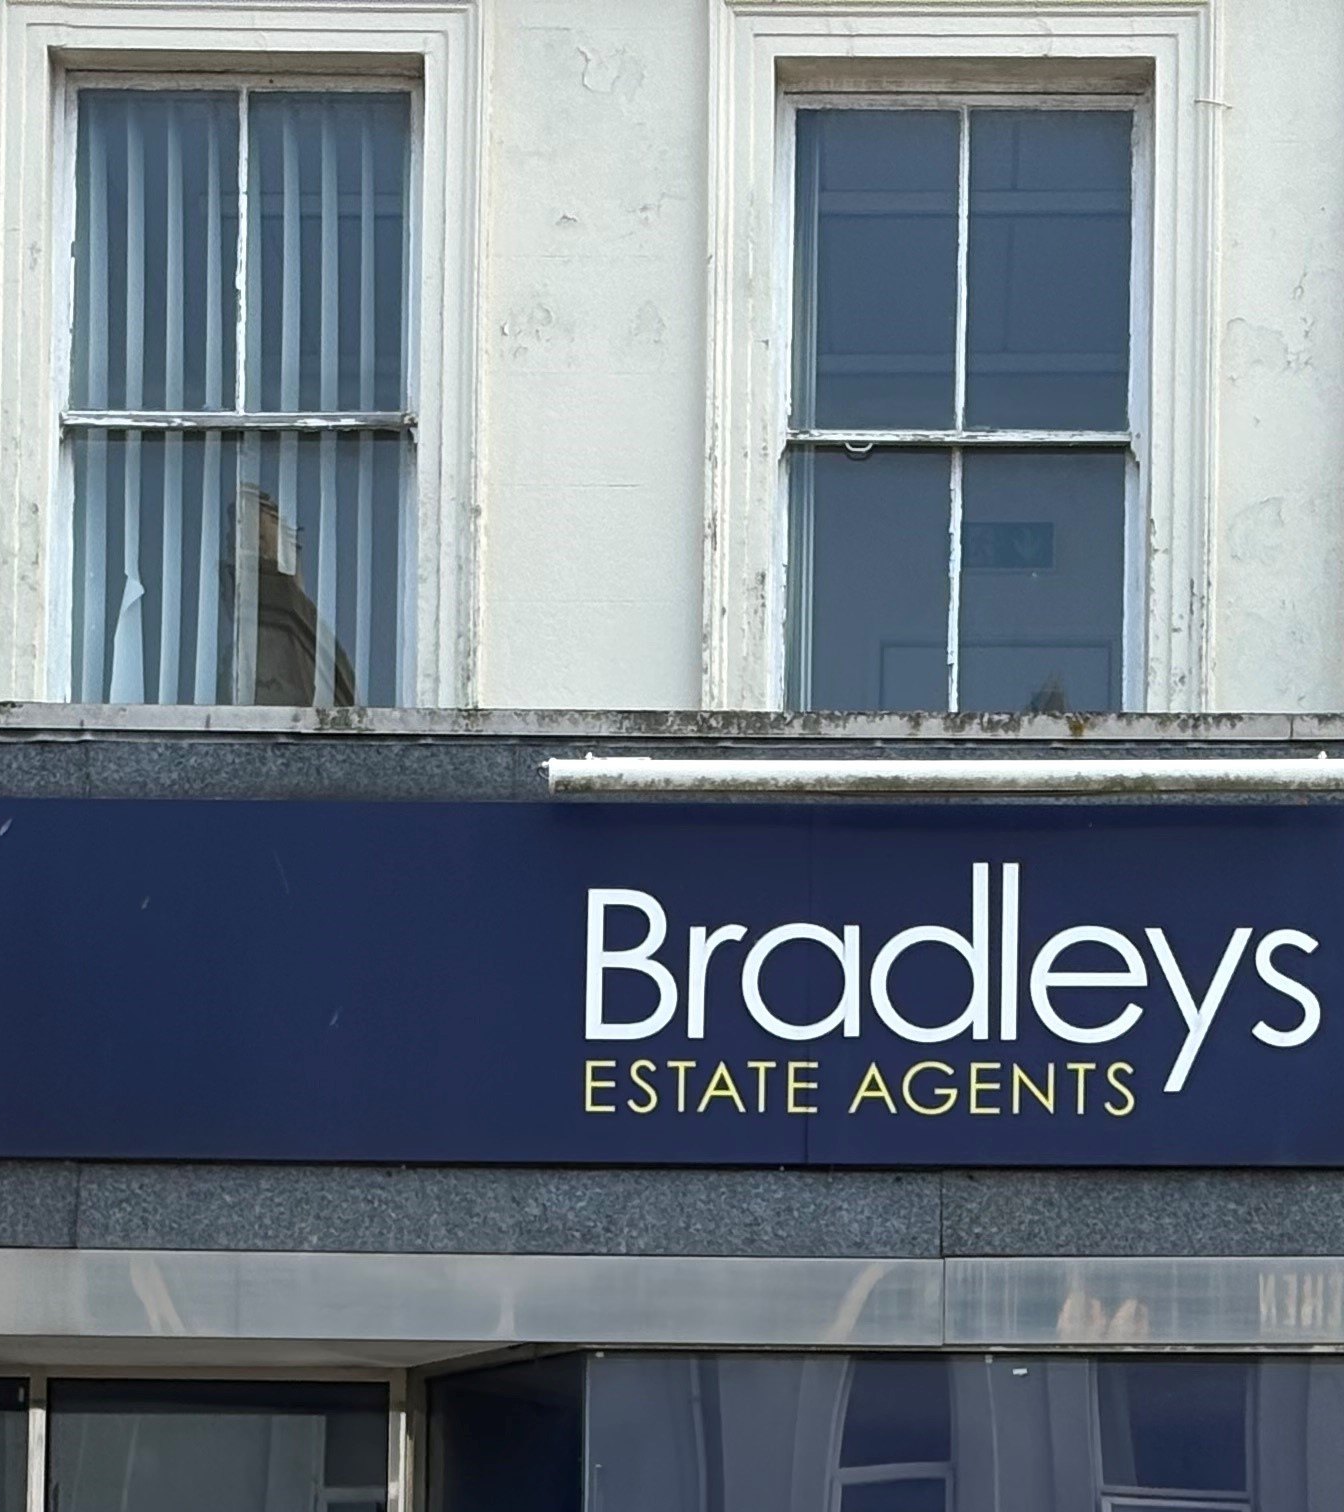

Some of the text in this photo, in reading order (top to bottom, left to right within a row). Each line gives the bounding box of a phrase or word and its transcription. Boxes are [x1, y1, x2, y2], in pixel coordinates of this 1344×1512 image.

[584, 862, 1322, 1093] Bradleys
[585, 1060, 1136, 1116] ESTATE AGENTS
